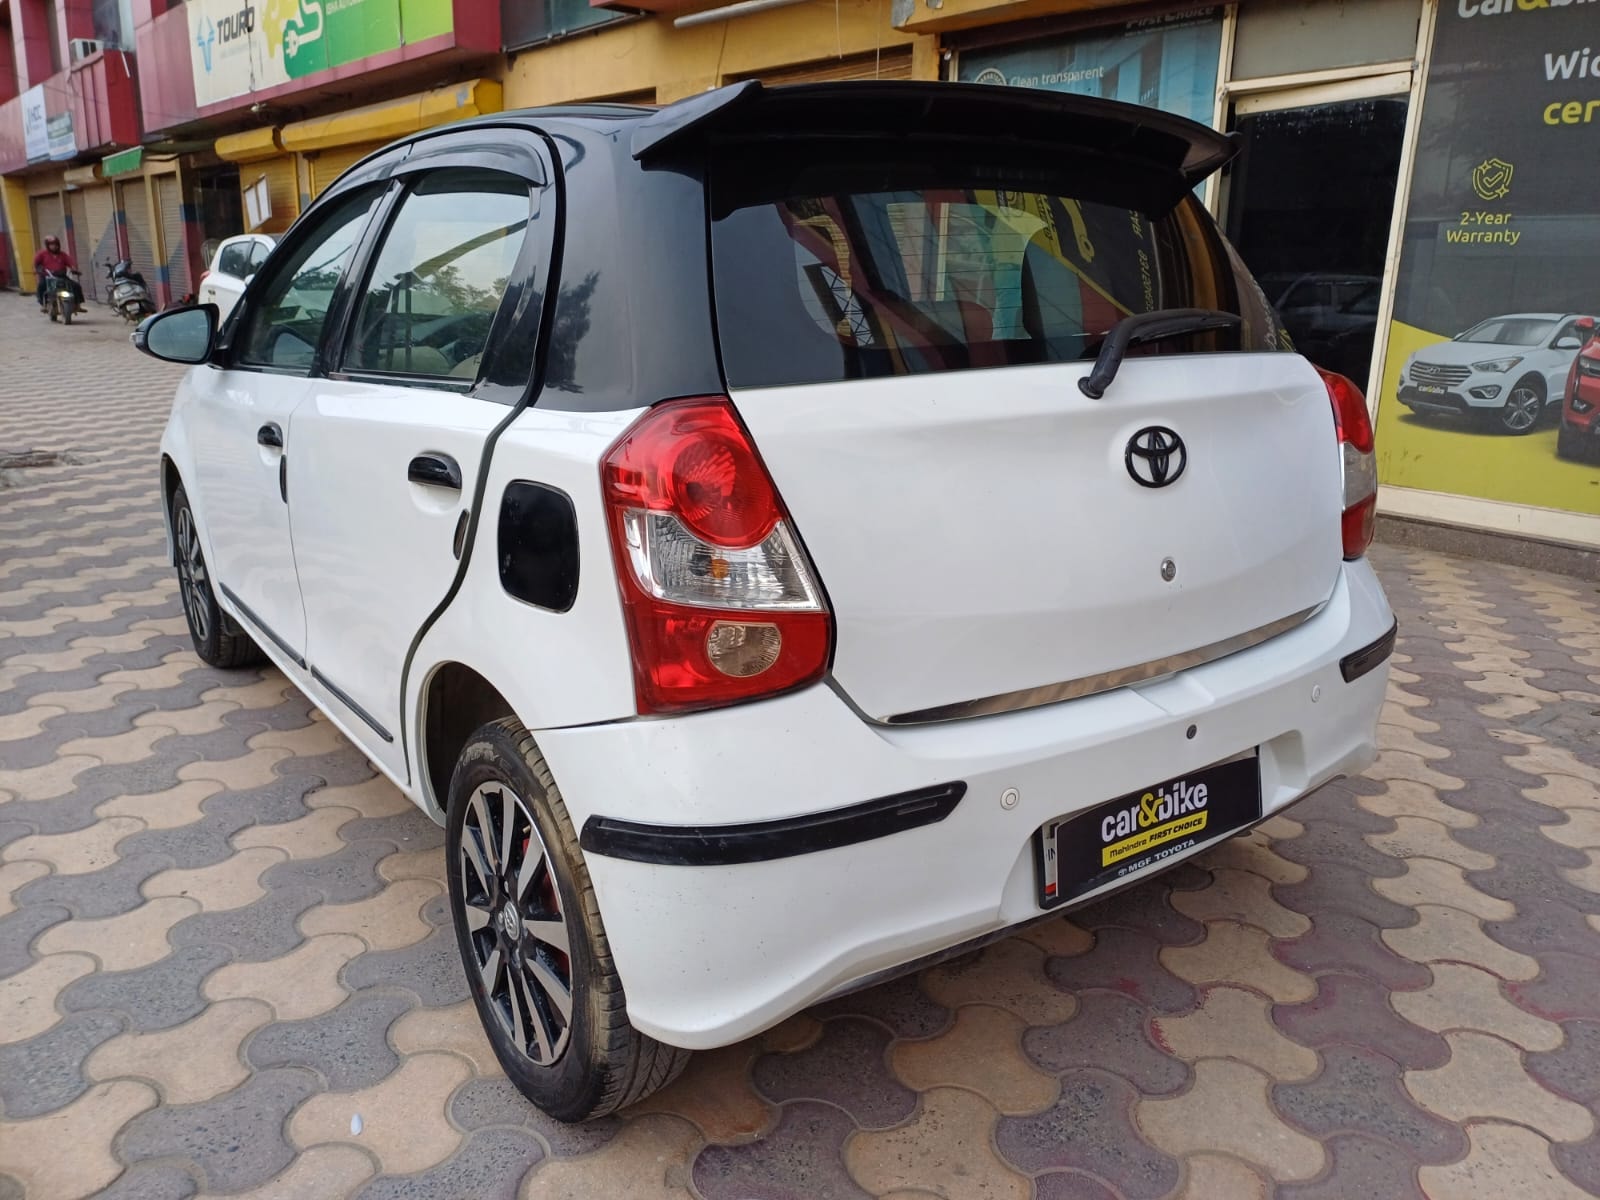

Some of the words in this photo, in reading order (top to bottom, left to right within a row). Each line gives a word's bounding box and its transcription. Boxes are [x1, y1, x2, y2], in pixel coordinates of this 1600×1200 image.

[1010, 76, 1038, 88] Clean
[1041, 66, 1105, 85] transparent
[1459, 211, 1512, 226] 2-Year
[1446, 229, 1520, 246] Warranty
[1101, 781, 1208, 843] car&bike
[1109, 838, 1147, 858] Mahindra
[1149, 828, 1174, 843] FIRST
[1173, 818, 1203, 834] CHOICE
[1128, 857, 1153, 873] MGF
[1154, 839, 1196, 860] TOYOTA
